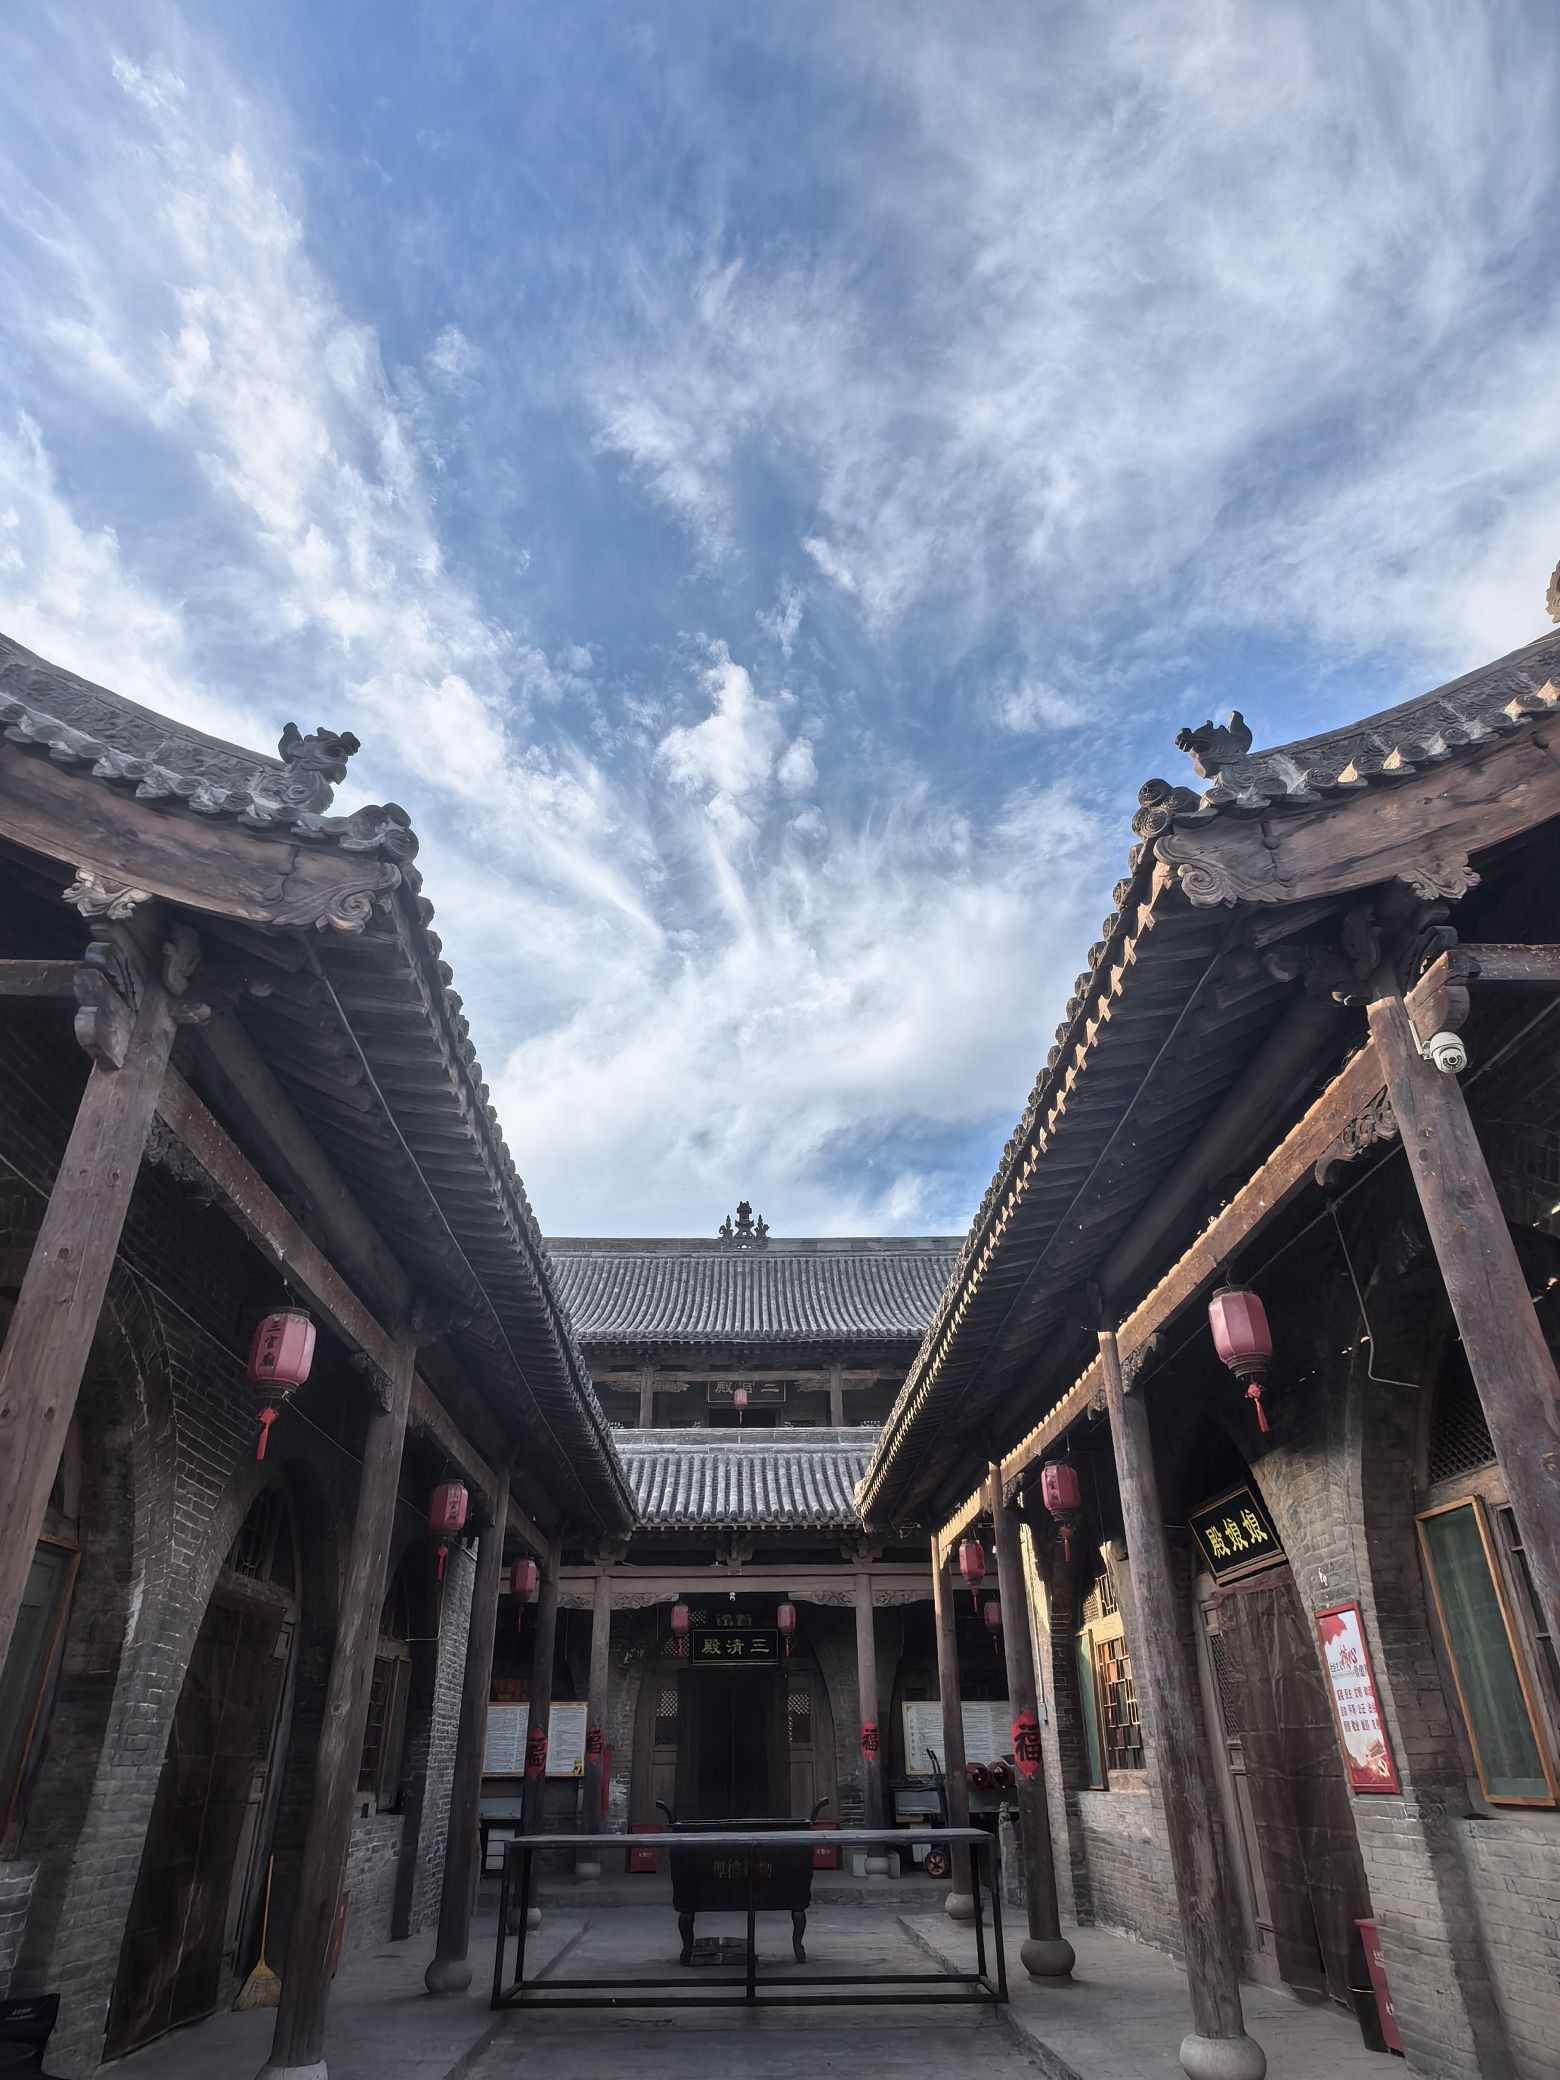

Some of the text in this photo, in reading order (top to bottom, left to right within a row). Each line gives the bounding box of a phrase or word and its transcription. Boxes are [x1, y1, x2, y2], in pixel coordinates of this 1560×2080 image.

[1204, 1508, 1268, 1559] 娘娘殿
[862, 1728, 879, 1751] 福
[1014, 1723, 1042, 1762] 福
